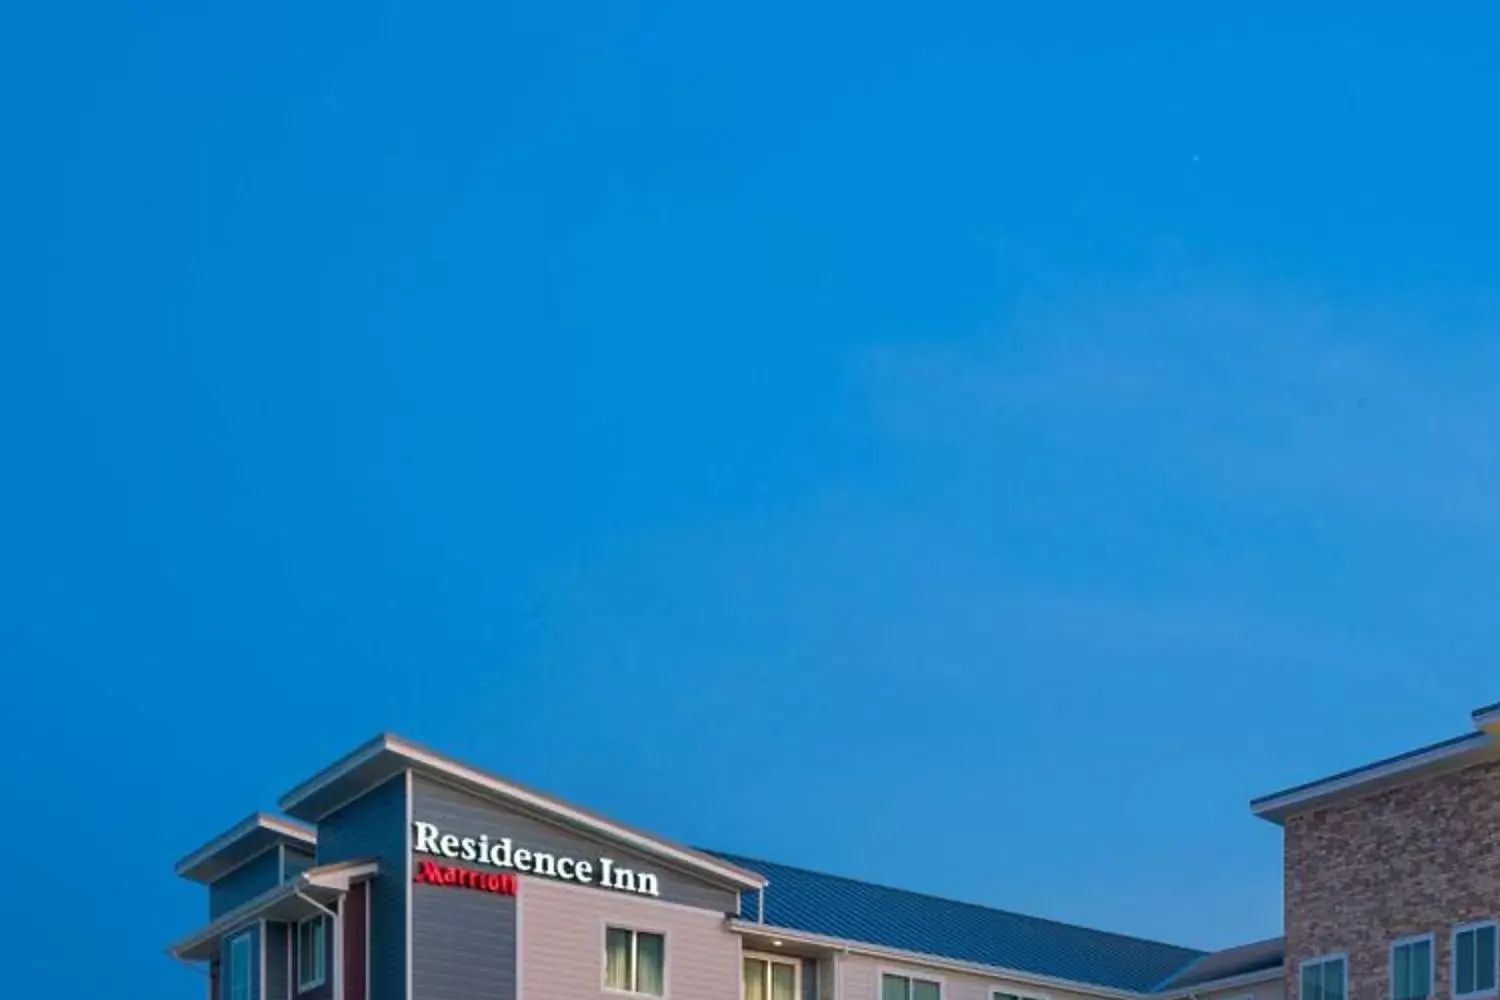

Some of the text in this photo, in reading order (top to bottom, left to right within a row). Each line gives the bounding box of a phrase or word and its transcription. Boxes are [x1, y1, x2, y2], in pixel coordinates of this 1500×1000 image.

[414, 820, 660, 897] Residence Inn
[415, 858, 517, 896] Marriott
